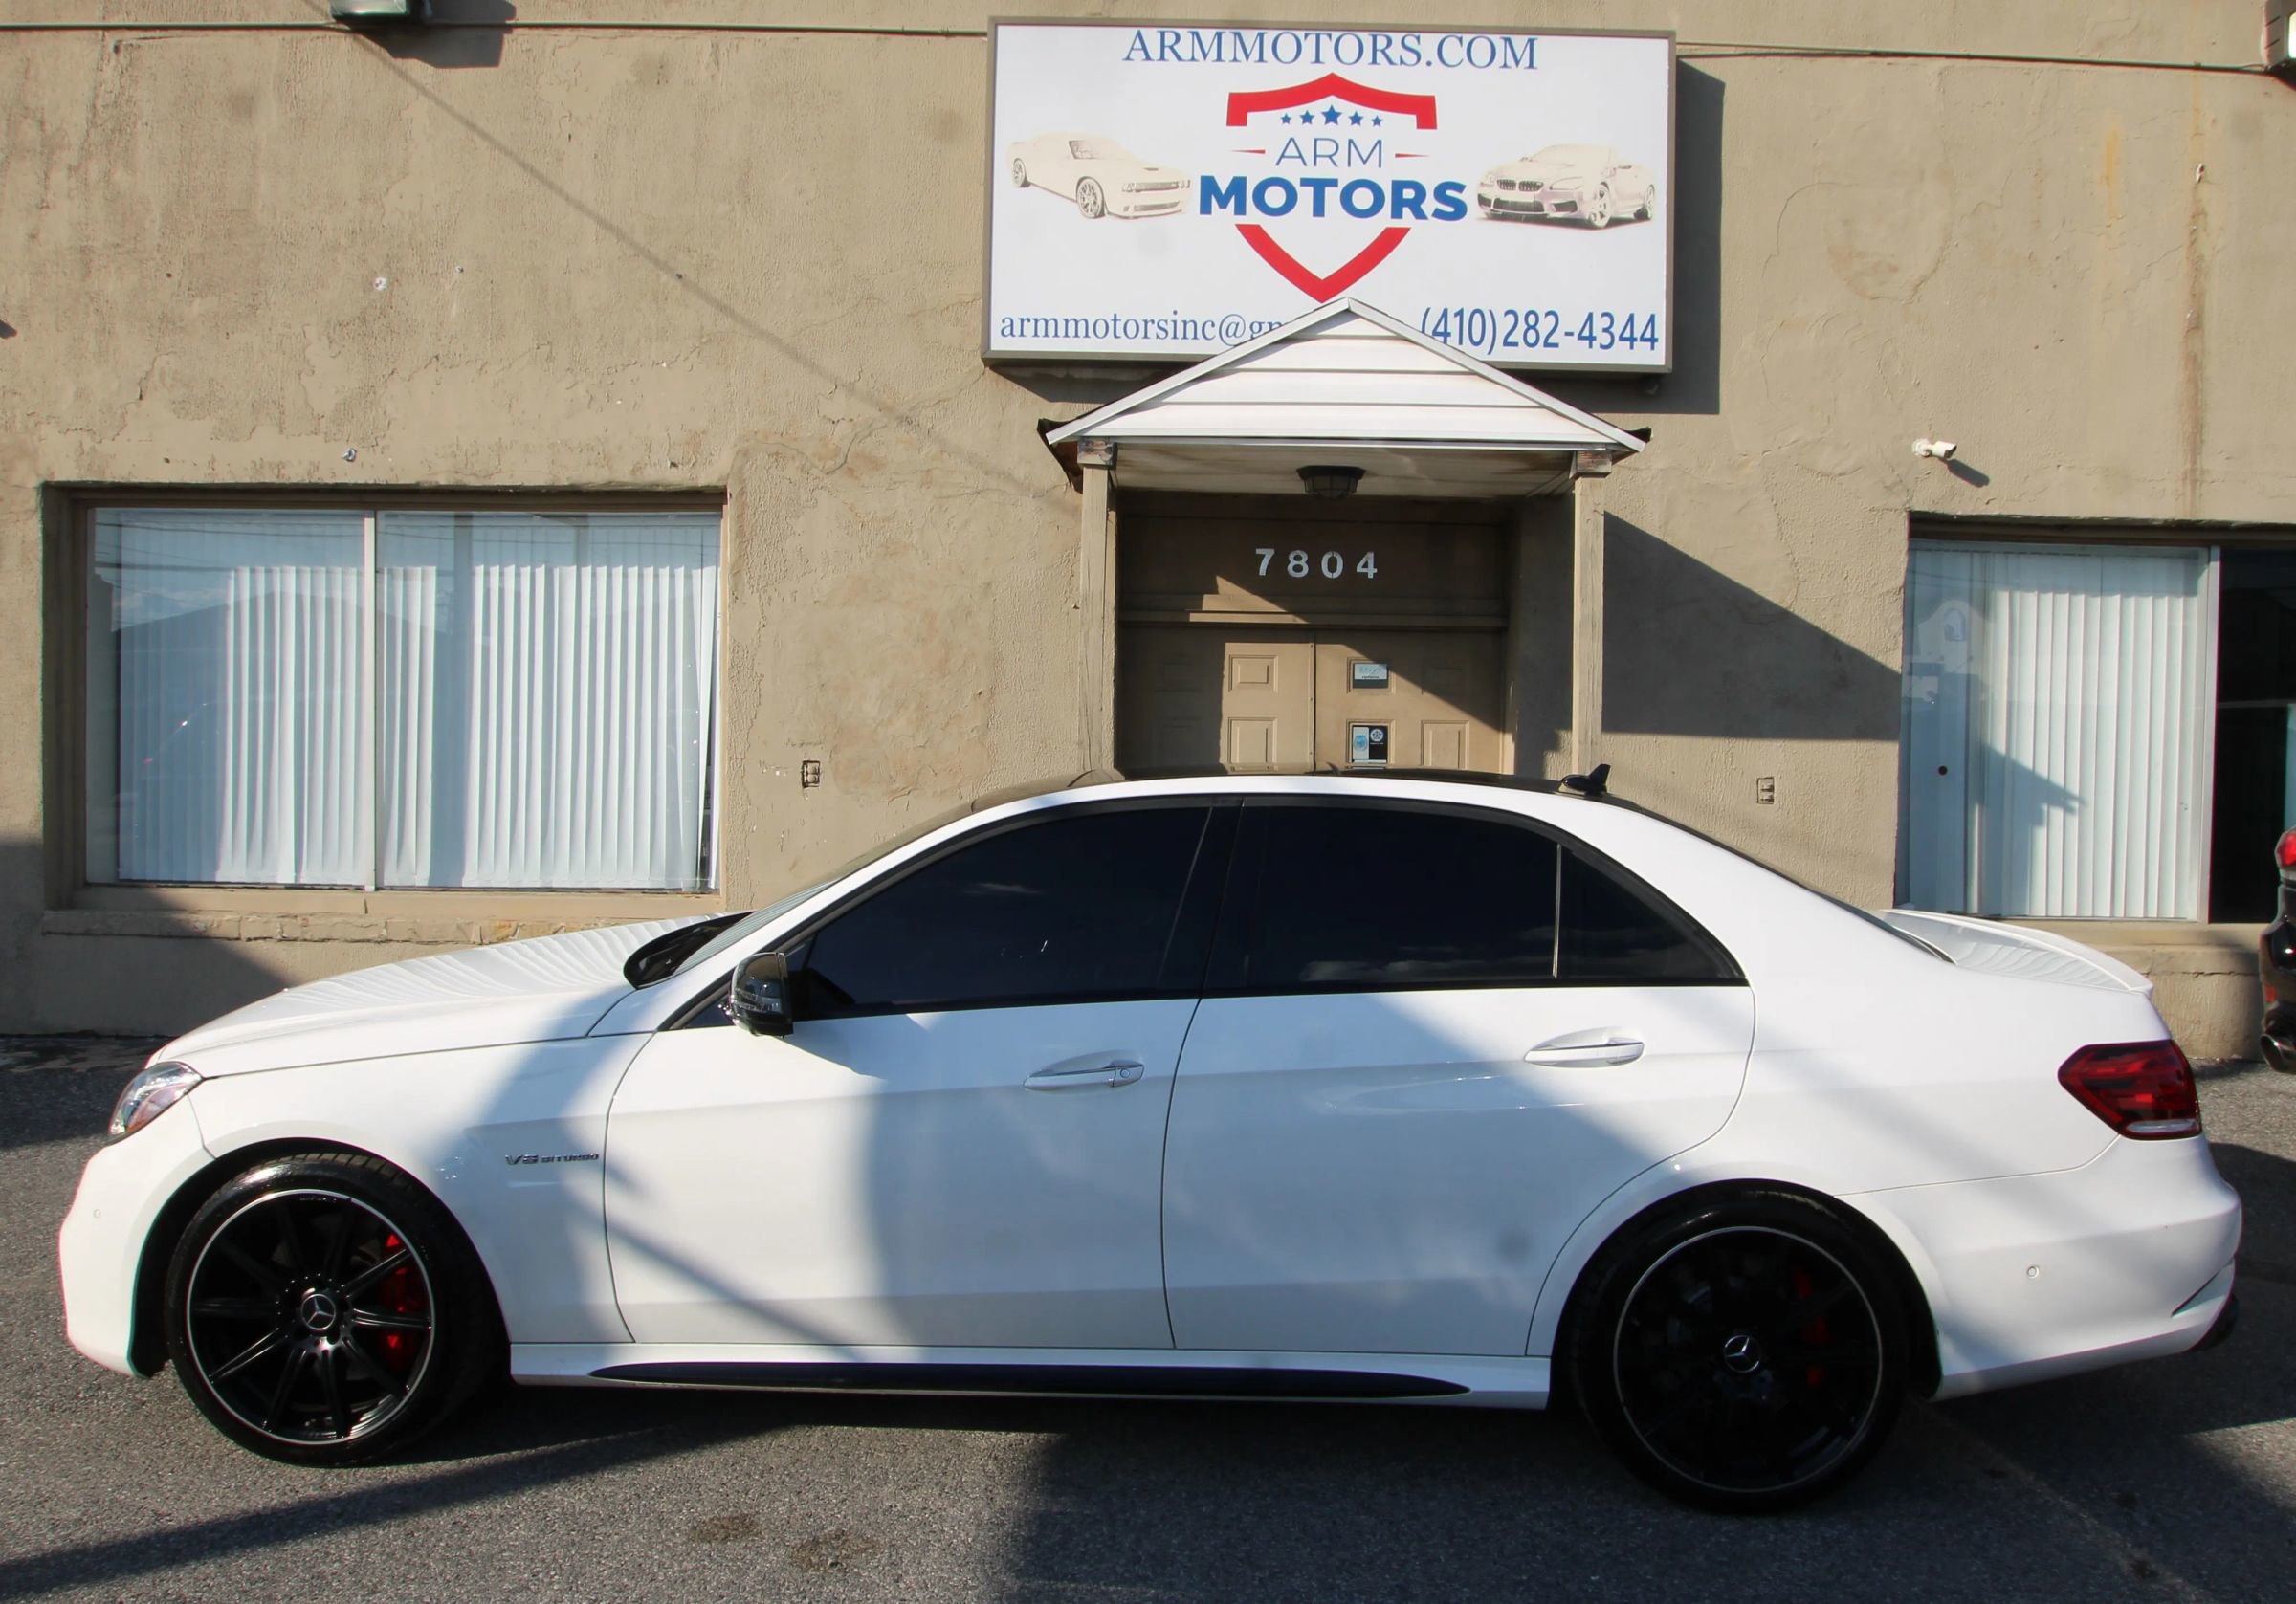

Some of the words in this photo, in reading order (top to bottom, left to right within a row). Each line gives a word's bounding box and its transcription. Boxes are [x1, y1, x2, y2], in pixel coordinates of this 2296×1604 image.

[1123, 29, 1538, 71] ARMMOTORS.COM
[1275, 137, 1383, 168] ARM
[1199, 174, 1468, 222] MOTORS
[1421, 306, 1660, 355] (410)282-4344
[1255, 548, 1378, 579] 7804
[504, 1153, 539, 1166] V8
[541, 1154, 599, 1163] BITURBO
